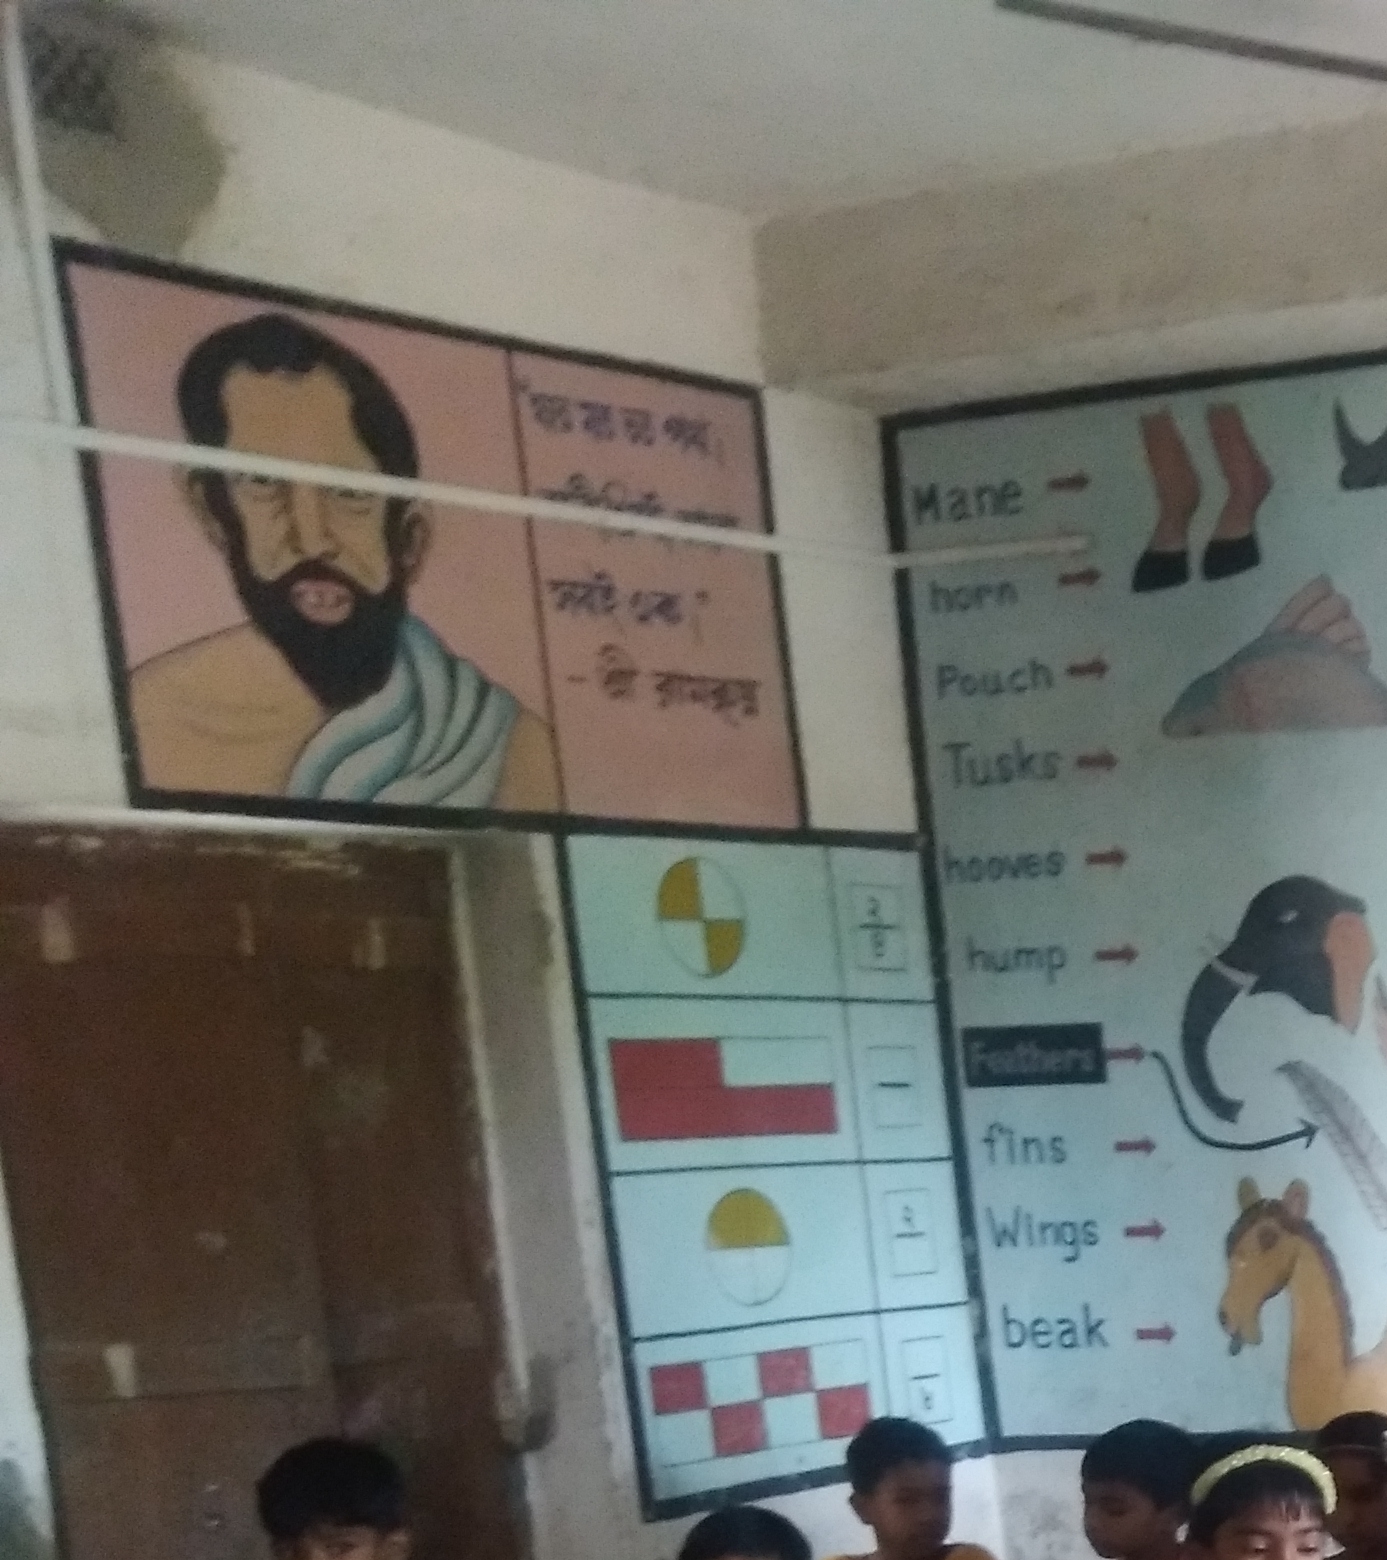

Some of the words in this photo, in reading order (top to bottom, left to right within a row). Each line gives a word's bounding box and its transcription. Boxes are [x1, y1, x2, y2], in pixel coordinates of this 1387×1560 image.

[911, 479, 1024, 526] Mane
[929, 579, 1019, 614] horn
[936, 657, 1056, 700] Pouch
[941, 738, 1063, 789] Tusks
[944, 849, 1066, 884] hooves
[966, 935, 1067, 988] hump
[982, 1120, 1068, 1165] fins
[985, 1204, 1100, 1263] Wings
[1002, 1302, 1110, 1349] beak
